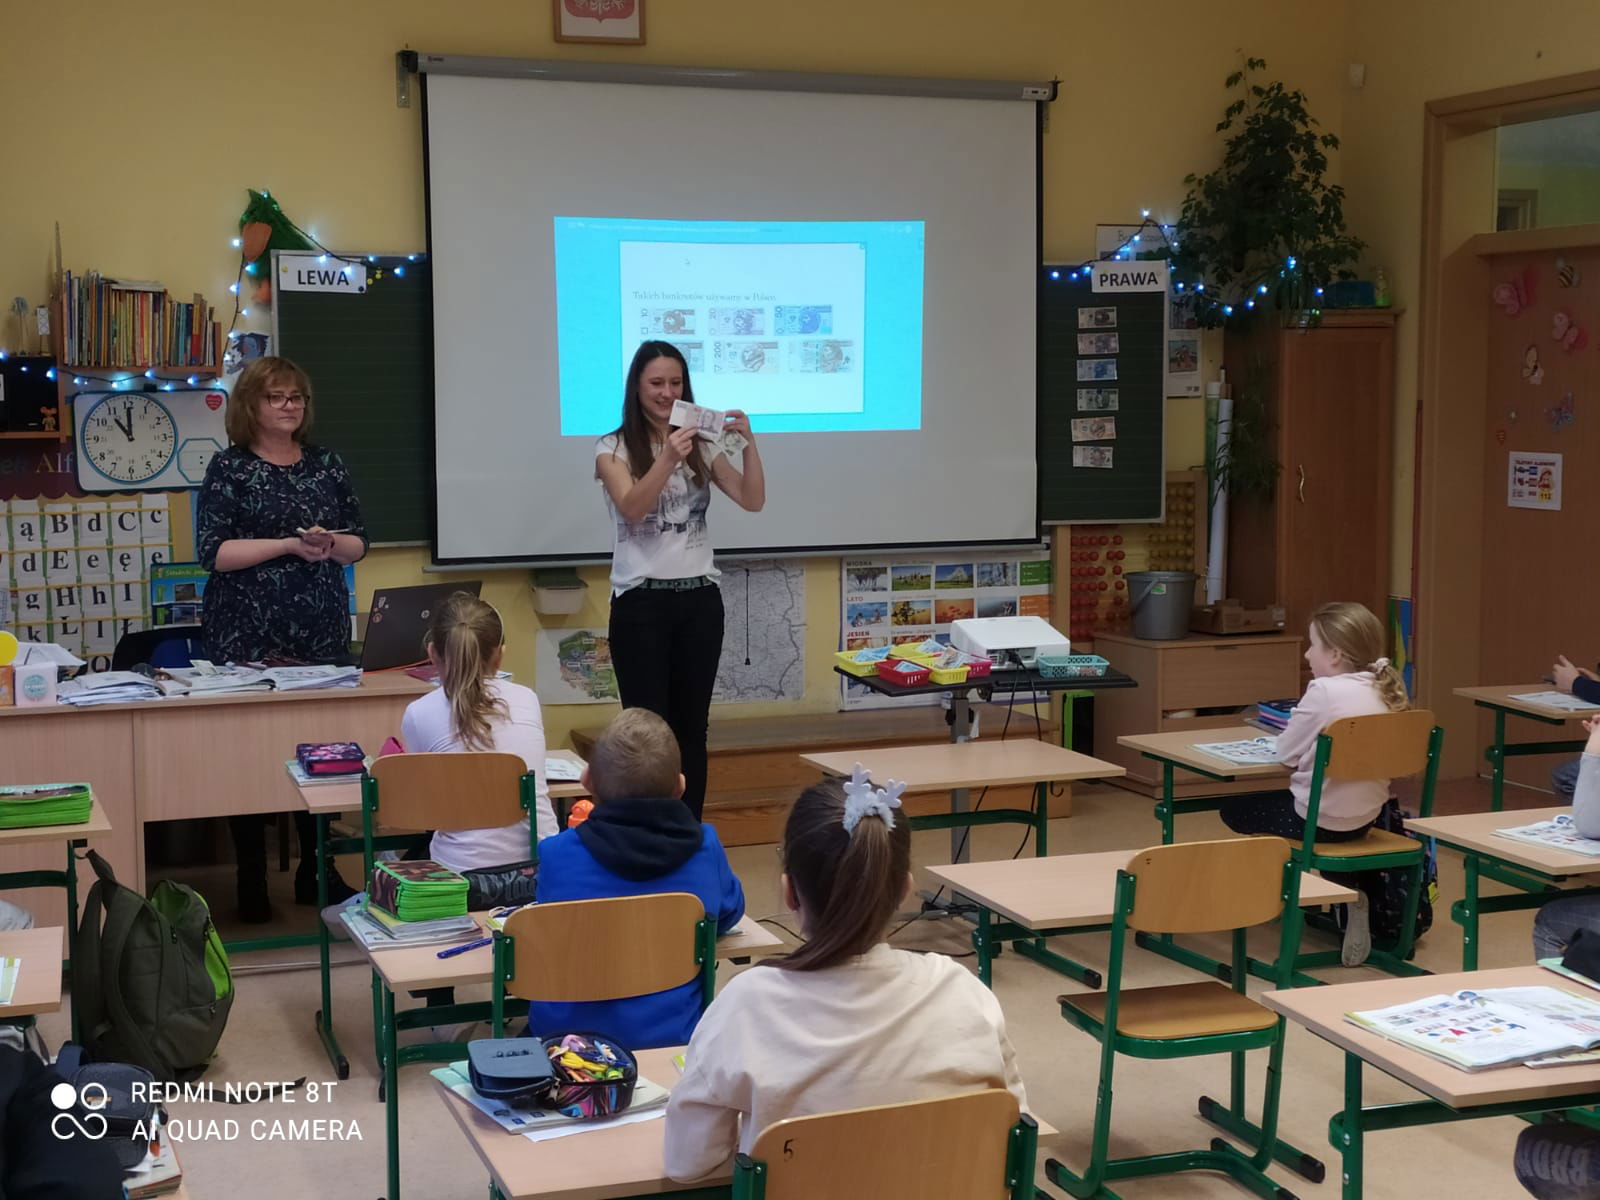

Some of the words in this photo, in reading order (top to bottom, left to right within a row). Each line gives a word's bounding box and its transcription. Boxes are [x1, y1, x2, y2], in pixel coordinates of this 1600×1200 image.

[297, 270, 350, 286] LEWA
[1099, 271, 1159, 287] PRAWA
[122, 401, 134, 410] 12
[143, 406, 148, 415] 1
[107, 406, 117, 416] 11
[96, 417, 107, 427] 10
[154, 416, 161, 426] 2
[93, 434, 100, 444] 9
[161, 432, 168, 442] 3
[99, 451, 106, 461] 8
[156, 449, 163, 459] 4
[111, 462, 117, 471] 7
[128, 464, 135, 474] 6
[145, 461, 152, 470] 5
[20, 521, 35, 542] ą
[51, 513, 69, 534] B
[118, 511, 137, 532] C
[22, 552, 37, 572] d
[52, 550, 69, 570] E
[87, 553, 99, 568] e
[119, 552, 131, 572] ę
[25, 593, 41, 610] g
[56, 586, 76, 607] H
[92, 585, 107, 605] h
[60, 615, 79, 636] L
